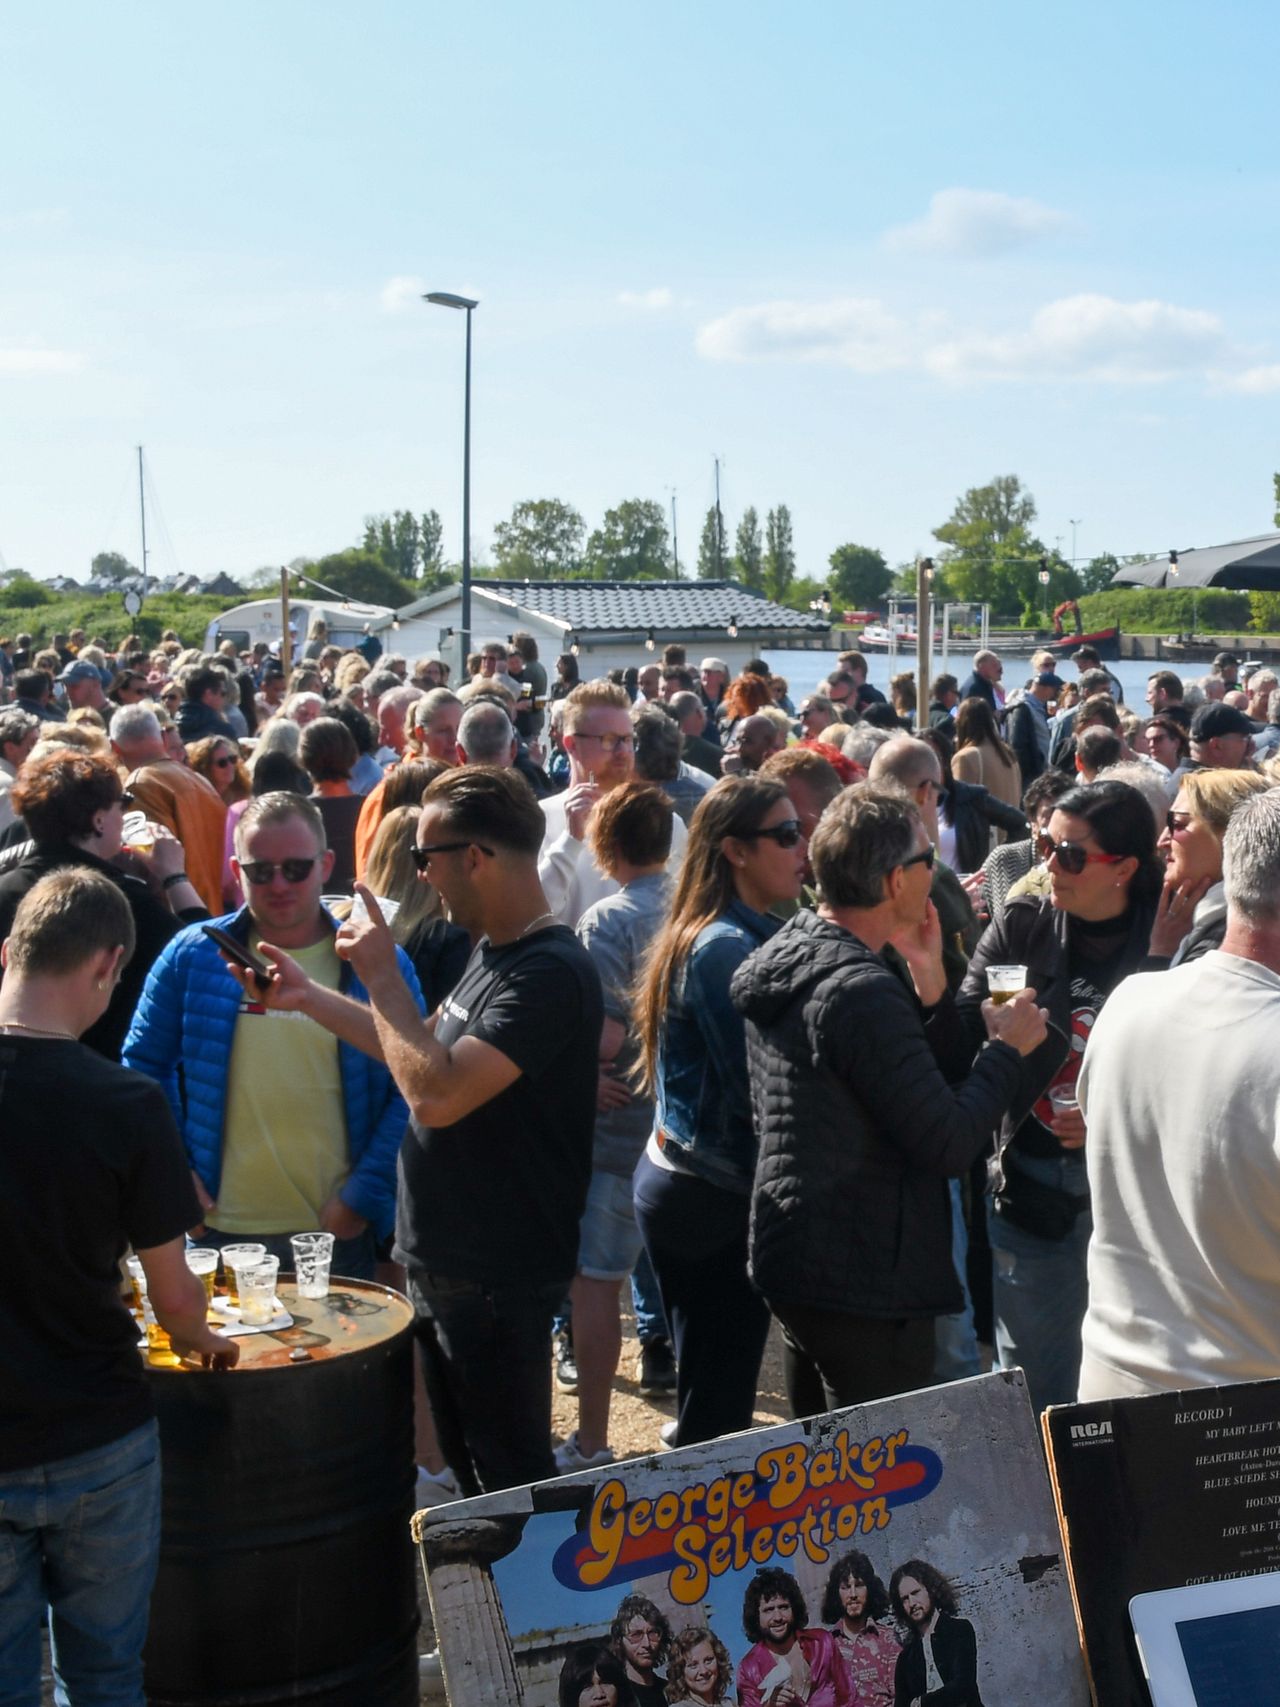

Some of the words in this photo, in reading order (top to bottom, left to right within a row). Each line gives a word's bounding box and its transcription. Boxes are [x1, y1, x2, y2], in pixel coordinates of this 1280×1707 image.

[1174, 1408, 1225, 1425] RECORD
[1070, 1421, 1113, 1439] RCA
[1205, 1429, 1220, 1439] MY
[1222, 1425, 1247, 1437] BABY
[1249, 1422, 1273, 1434] LEFT
[1195, 1449, 1260, 1466] HEARTBREAK
[1204, 1477, 1231, 1490] BLUE
[1233, 1472, 1267, 1485] SUEDE
[578, 1479, 756, 1585] George
[756, 1428, 909, 1509] Baker
[1222, 1525, 1248, 1537] LOVE
[1250, 1523, 1266, 1533] ME
[669, 1496, 890, 1604] Selection
